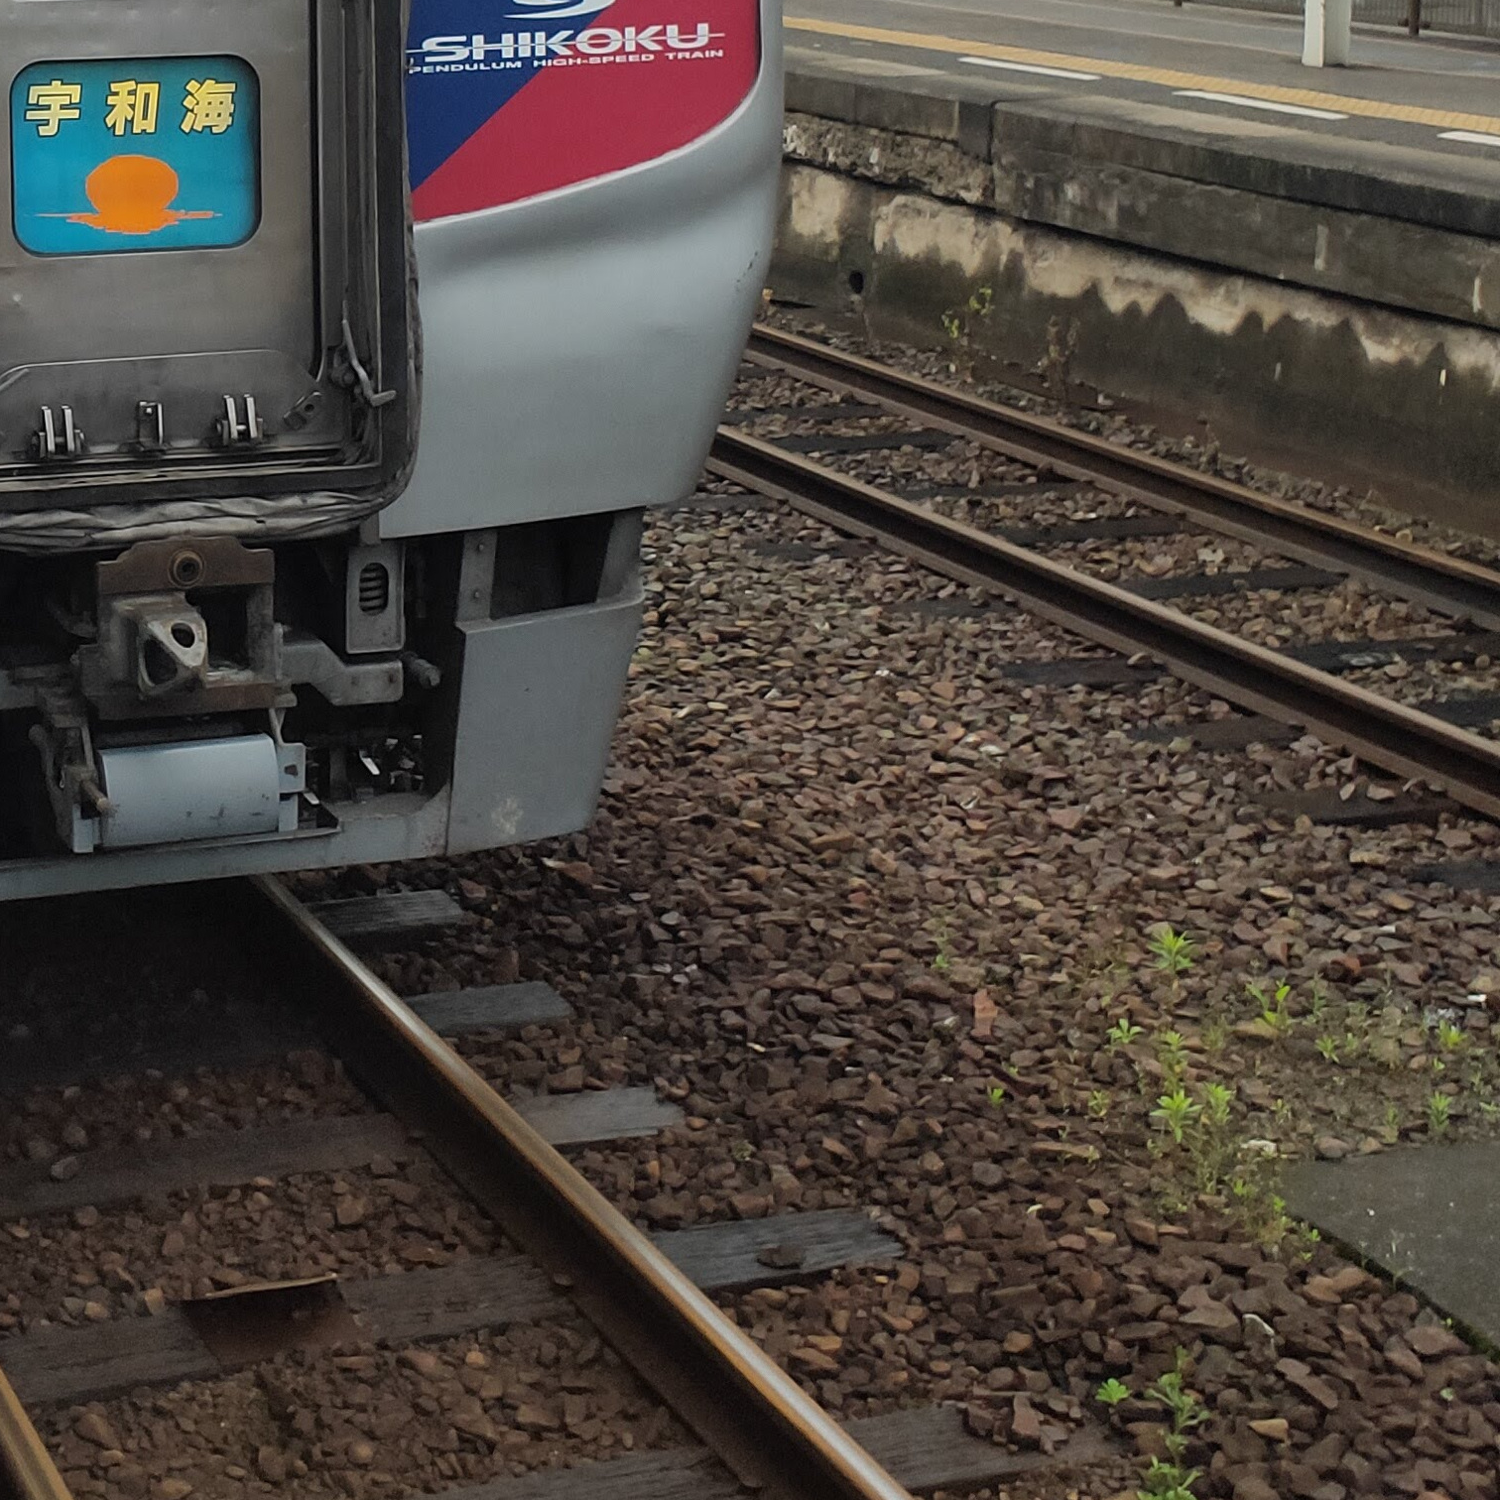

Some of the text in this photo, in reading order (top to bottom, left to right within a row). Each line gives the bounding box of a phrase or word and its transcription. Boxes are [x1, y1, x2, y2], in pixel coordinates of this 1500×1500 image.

[421, 22, 711, 63] SHIKOKU
[533, 53, 655, 68] HIGH-SPEED
[664, 49, 724, 61] TRAIN
[23, 78, 238, 138] 宇和海
